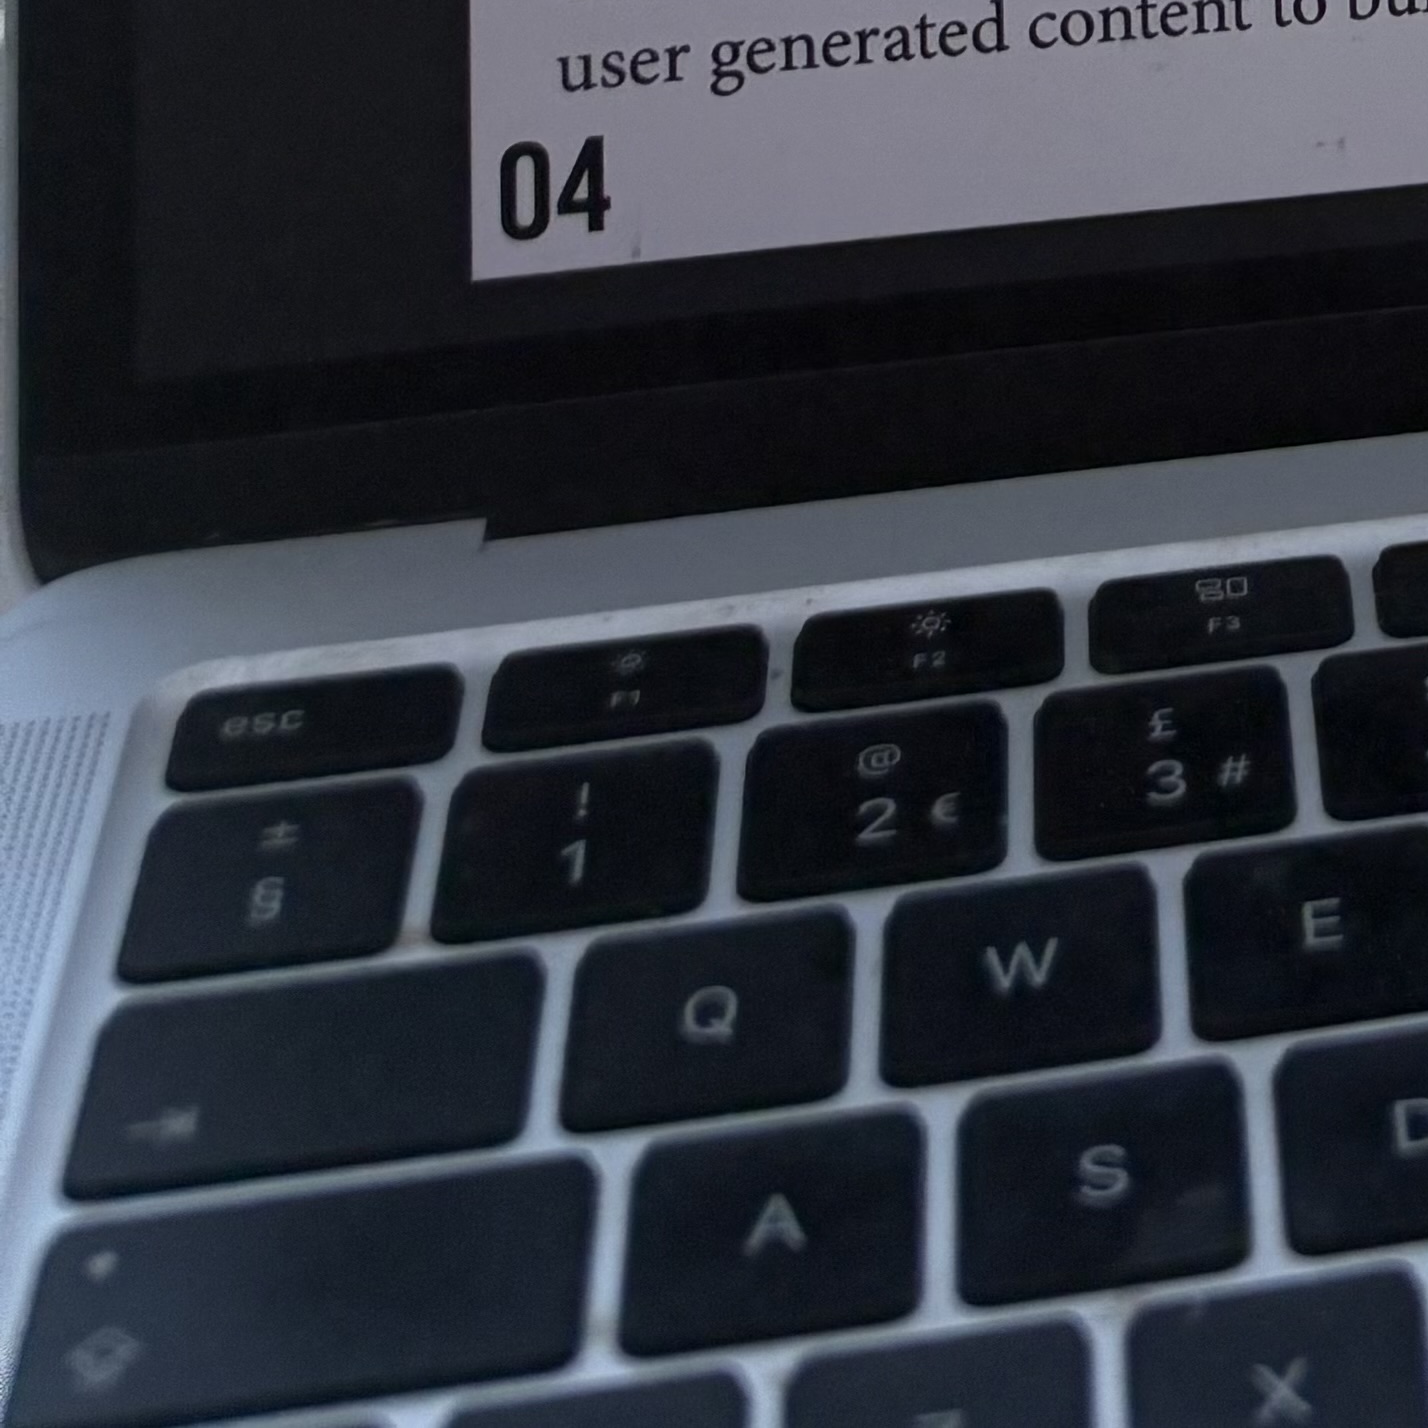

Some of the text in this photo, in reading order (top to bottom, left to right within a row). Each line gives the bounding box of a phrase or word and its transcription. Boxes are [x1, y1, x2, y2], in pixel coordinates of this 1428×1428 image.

[557, 45, 690, 92] user
[500, 136, 610, 240] 04
[219, 709, 304, 740] esc
[1146, 759, 1187, 805] 3
[856, 796, 897, 845] 2
[561, 839, 586, 884] 1
[1301, 897, 1344, 949] E
[984, 937, 1059, 994] W
[681, 985, 739, 1042] Q
[1078, 1143, 1130, 1206] S
[744, 1193, 806, 1256] A
[1256, 1359, 1311, 1424] X
